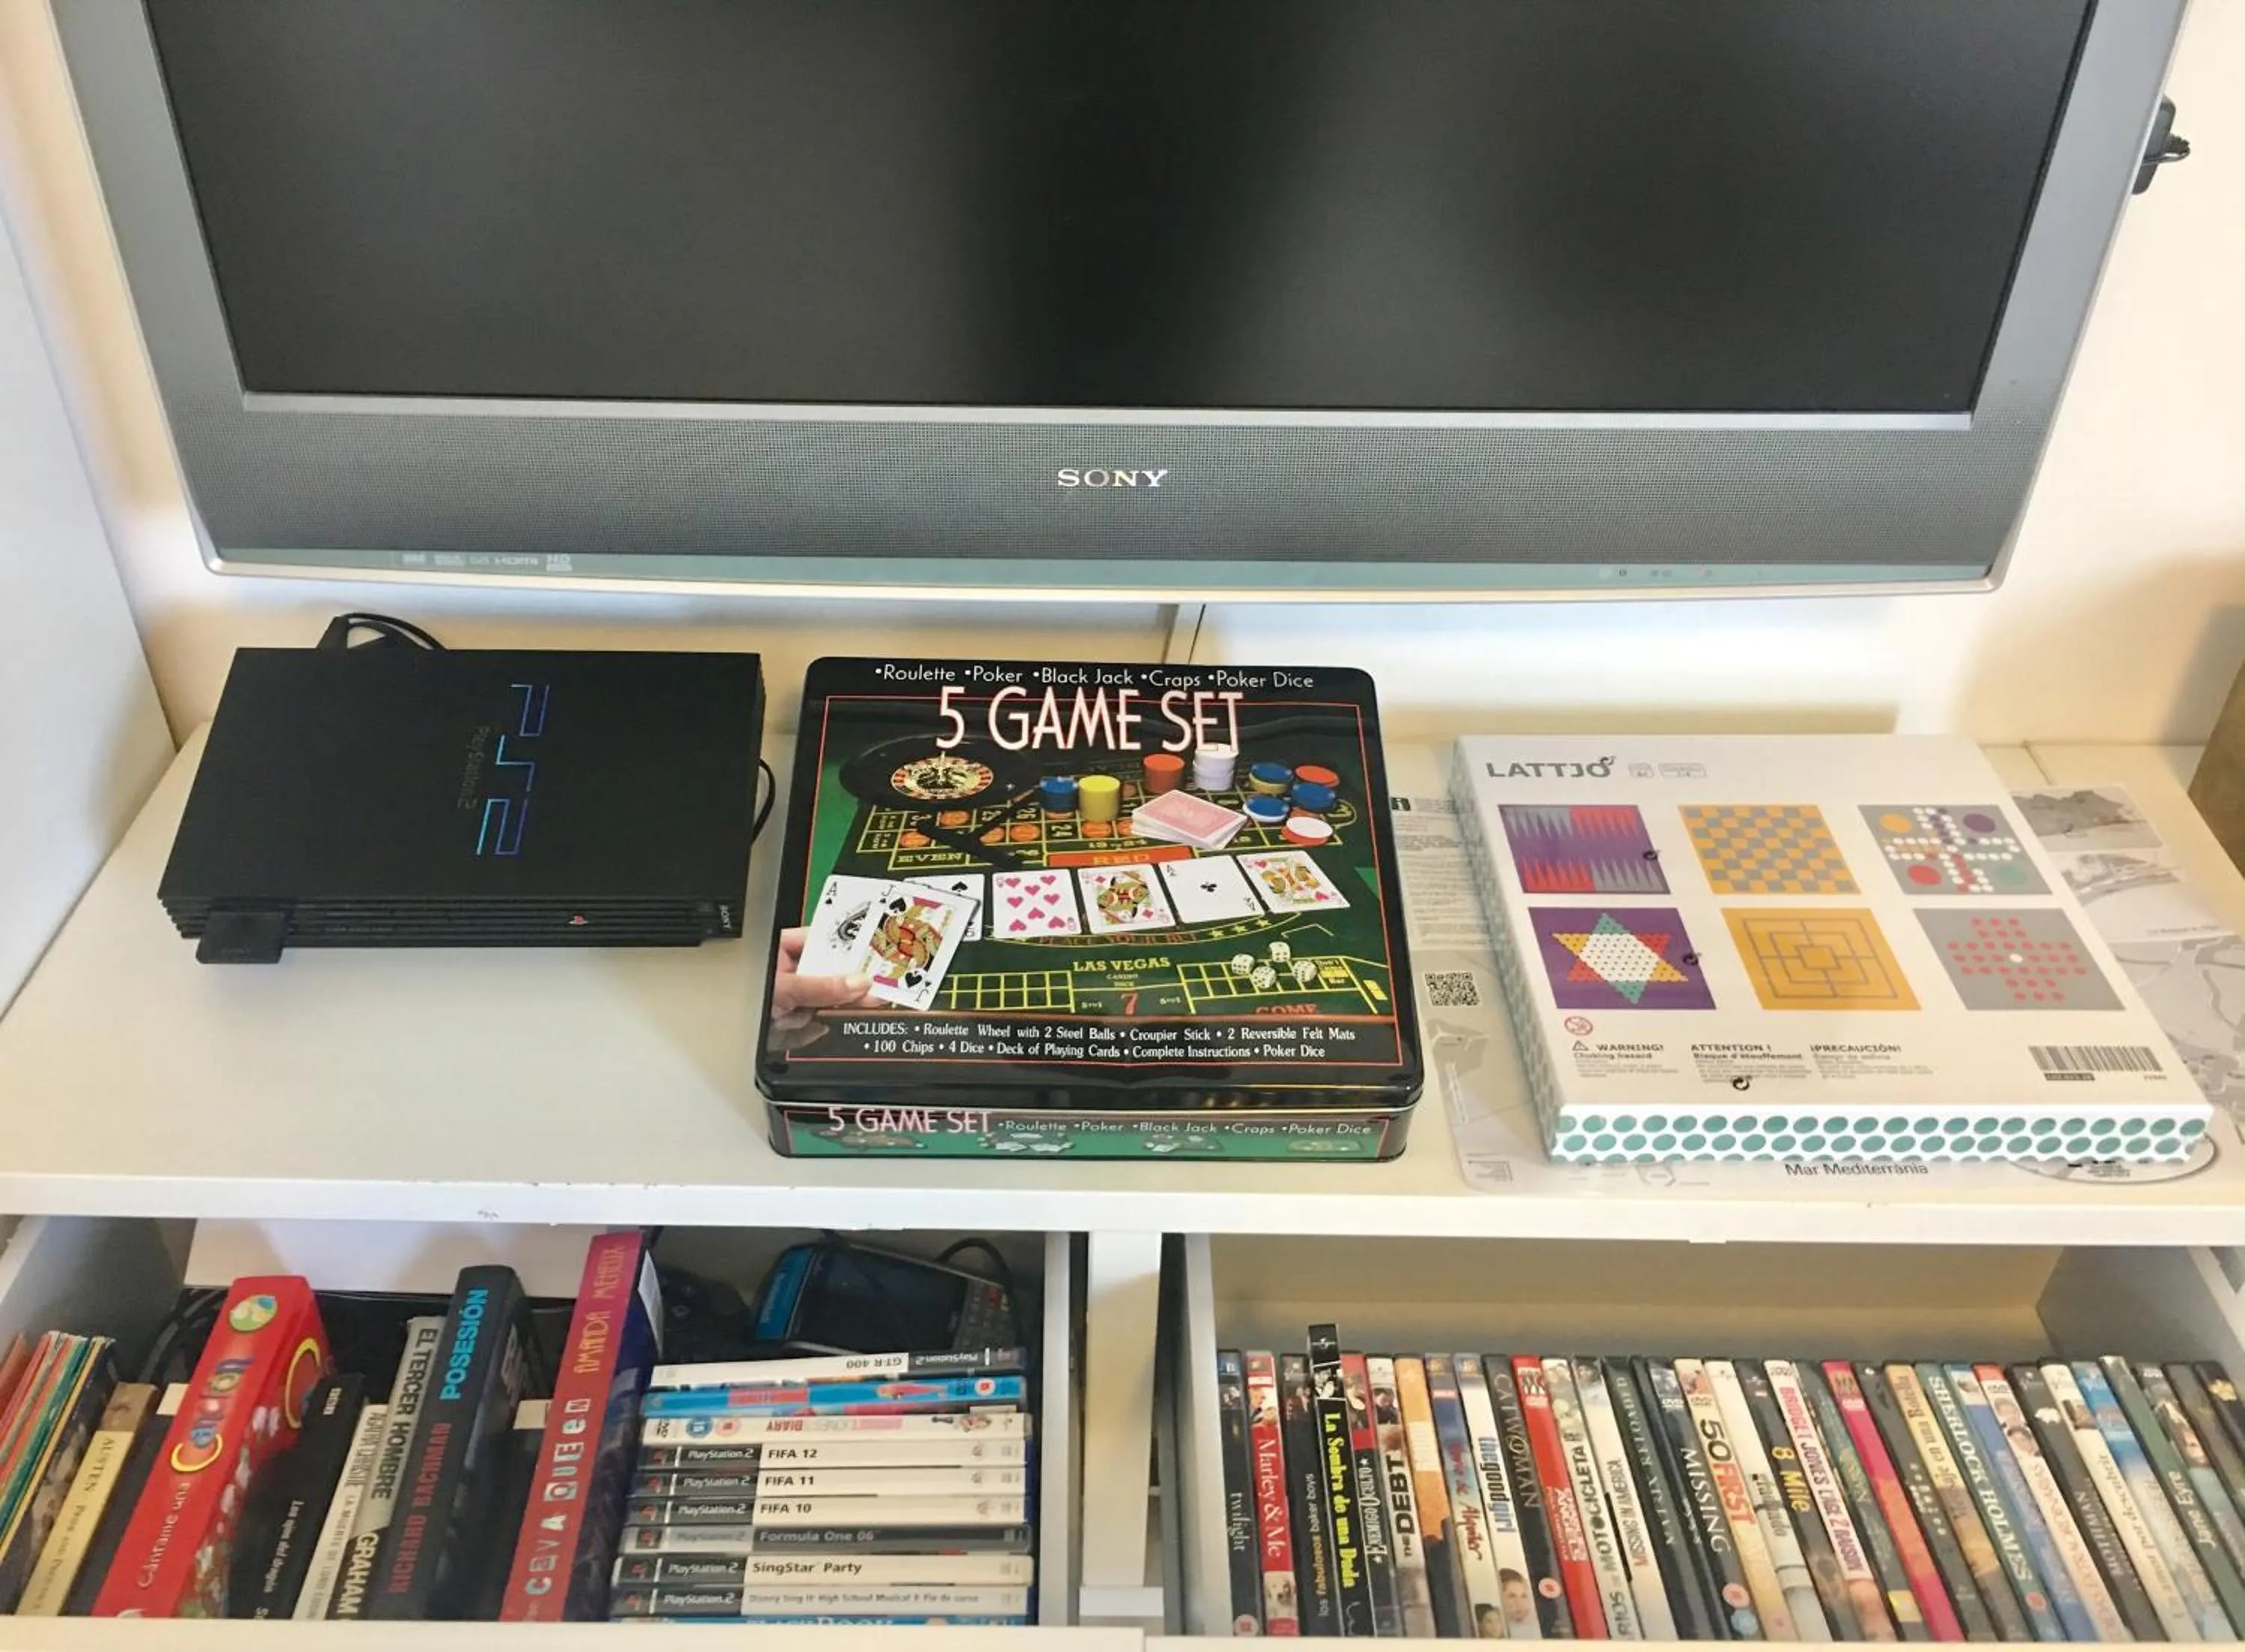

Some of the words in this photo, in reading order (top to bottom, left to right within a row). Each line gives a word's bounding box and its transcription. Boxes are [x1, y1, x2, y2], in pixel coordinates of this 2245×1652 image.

[1057, 468, 1168, 487] SONY
[884, 664, 956, 682] Roulette
[974, 665, 1023, 682] Poker
[1042, 667, 1089, 684] Black
[1094, 668, 1134, 685] Jack
[1149, 670, 1200, 691] Craps
[1217, 670, 1266, 688] Poker
[1274, 672, 1314, 688] Dice
[936, 685, 965, 749] 5
[988, 685, 1142, 750] GAME
[1161, 689, 1244, 752] SET
[1093, 854, 1150, 866] RED
[1072, 961, 1107, 972] LAS
[1110, 957, 1170, 971] VEGAS
[1120, 992, 1138, 1015] 7
[843, 1023, 908, 1035] INCLUDES:
[923, 1023, 969, 1036] Roulette
[977, 1024, 1010, 1038] Wheel
[1017, 1026, 1039, 1038] with
[1044, 1027, 1051, 1038] 2
[1056, 1027, 1083, 1039] Steel
[1089, 1027, 1115, 1040] Balls
[1130, 1028, 1176, 1042] Croupier
[1184, 1028, 1211, 1041] Stick
[1227, 1028, 1235, 1040] 2
[1241, 1027, 1297, 1040] Reversible
[1303, 1028, 1324, 1040] Felt
[1328, 1028, 1356, 1041] Mats
[873, 1041, 897, 1053] 100
[902, 1041, 935, 1054] Chips
[948, 1041, 956, 1053] 4
[960, 1041, 985, 1053] Dice
[996, 1041, 1024, 1055] Deck
[1028, 1042, 1039, 1055] of
[1044, 1042, 1084, 1059] Playing
[1089, 1045, 1120, 1058] Cards
[1132, 1045, 1185, 1059] Complete
[1188, 1044, 1250, 1058] Instructions
[1263, 1044, 1295, 1057] Poker
[1300, 1044, 1325, 1057] Dice
[1596, 1043, 1664, 1051] WARNING!
[1690, 1043, 1765, 1052] ATTENTION
[828, 1107, 845, 1131] 5
[855, 1107, 938, 1133] GAME
[947, 1109, 992, 1133] SET
[1006, 1120, 1066, 1131] Roulette
[1081, 1121, 1123, 1131] Poker
[1140, 1122, 1179, 1132] Black
[1185, 1122, 1218, 1134] Jack
[1231, 1123, 1275, 1135] Craps
[1288, 1123, 1332, 1134] Poker
[1336, 1124, 1371, 1134] Dice
[1784, 1163, 1819, 1176] Mar
[418, 1327, 439, 1347] EL
[400, 1347, 432, 1416] TERCER
[766, 1419, 804, 1431] DIARY
[1324, 1412, 1343, 1434] La
[388, 1514, 427, 1594] RICHARD
[414, 1422, 452, 1507] BACHMAN
[439, 1287, 490, 1401] POSESIÓN
[1494, 1374, 1541, 1509] CATWOMAN
[1700, 1419, 1732, 1461] 50
[1778, 1387, 1813, 1440] BRIDGET
[1801, 1441, 1830, 1487] JONES
[373, 1420, 413, 1501] HOMBRE
[768, 1448, 798, 1458] FIFA
[802, 1448, 818, 1458] 12
[1327, 1437, 1348, 1493] Sombra
[1771, 1446, 1795, 1461] 8
[84, 1437, 115, 1498] AUSTEN
[765, 1476, 794, 1486] FIFA
[800, 1475, 815, 1485] 11
[1256, 1438, 1283, 1504] Marley
[1928, 1375, 1990, 1489] SHERLOCK
[1981, 1486, 2033, 1582] HOLMES
[1304, 1472, 1319, 1498] boys
[1386, 1455, 1415, 1535] DEBT
[1711, 1461, 1757, 1525] FIRST
[1780, 1470, 1812, 1514] Mile
[2167, 1469, 2194, 1506] Eyre
[760, 1503, 790, 1514] FIFA
[796, 1503, 812, 1514] 10
[1262, 1503, 1284, 1522] &
[1334, 1494, 1348, 1515] de
[1570, 1443, 1616, 1571] MOTOCICLETA
[1680, 1448, 1731, 1554] MISSING
[1227, 1492, 1253, 1552] twilight
[1308, 1499, 1320, 1533] baker
[2184, 1507, 2217, 1550] Jane
[760, 1532, 819, 1542] Formula
[824, 1531, 852, 1541] One
[857, 1531, 874, 1541] 06
[1265, 1522, 1289, 1558] Me
[1337, 1517, 1351, 1544] una
[336, 1531, 380, 1615] GRAHAM
[753, 1561, 816, 1574] SingStar
[824, 1561, 863, 1573] Party
[1312, 1534, 1328, 1597] fabulosos
[1339, 1547, 1357, 1588] Duda
[1318, 1597, 1330, 1618] los
